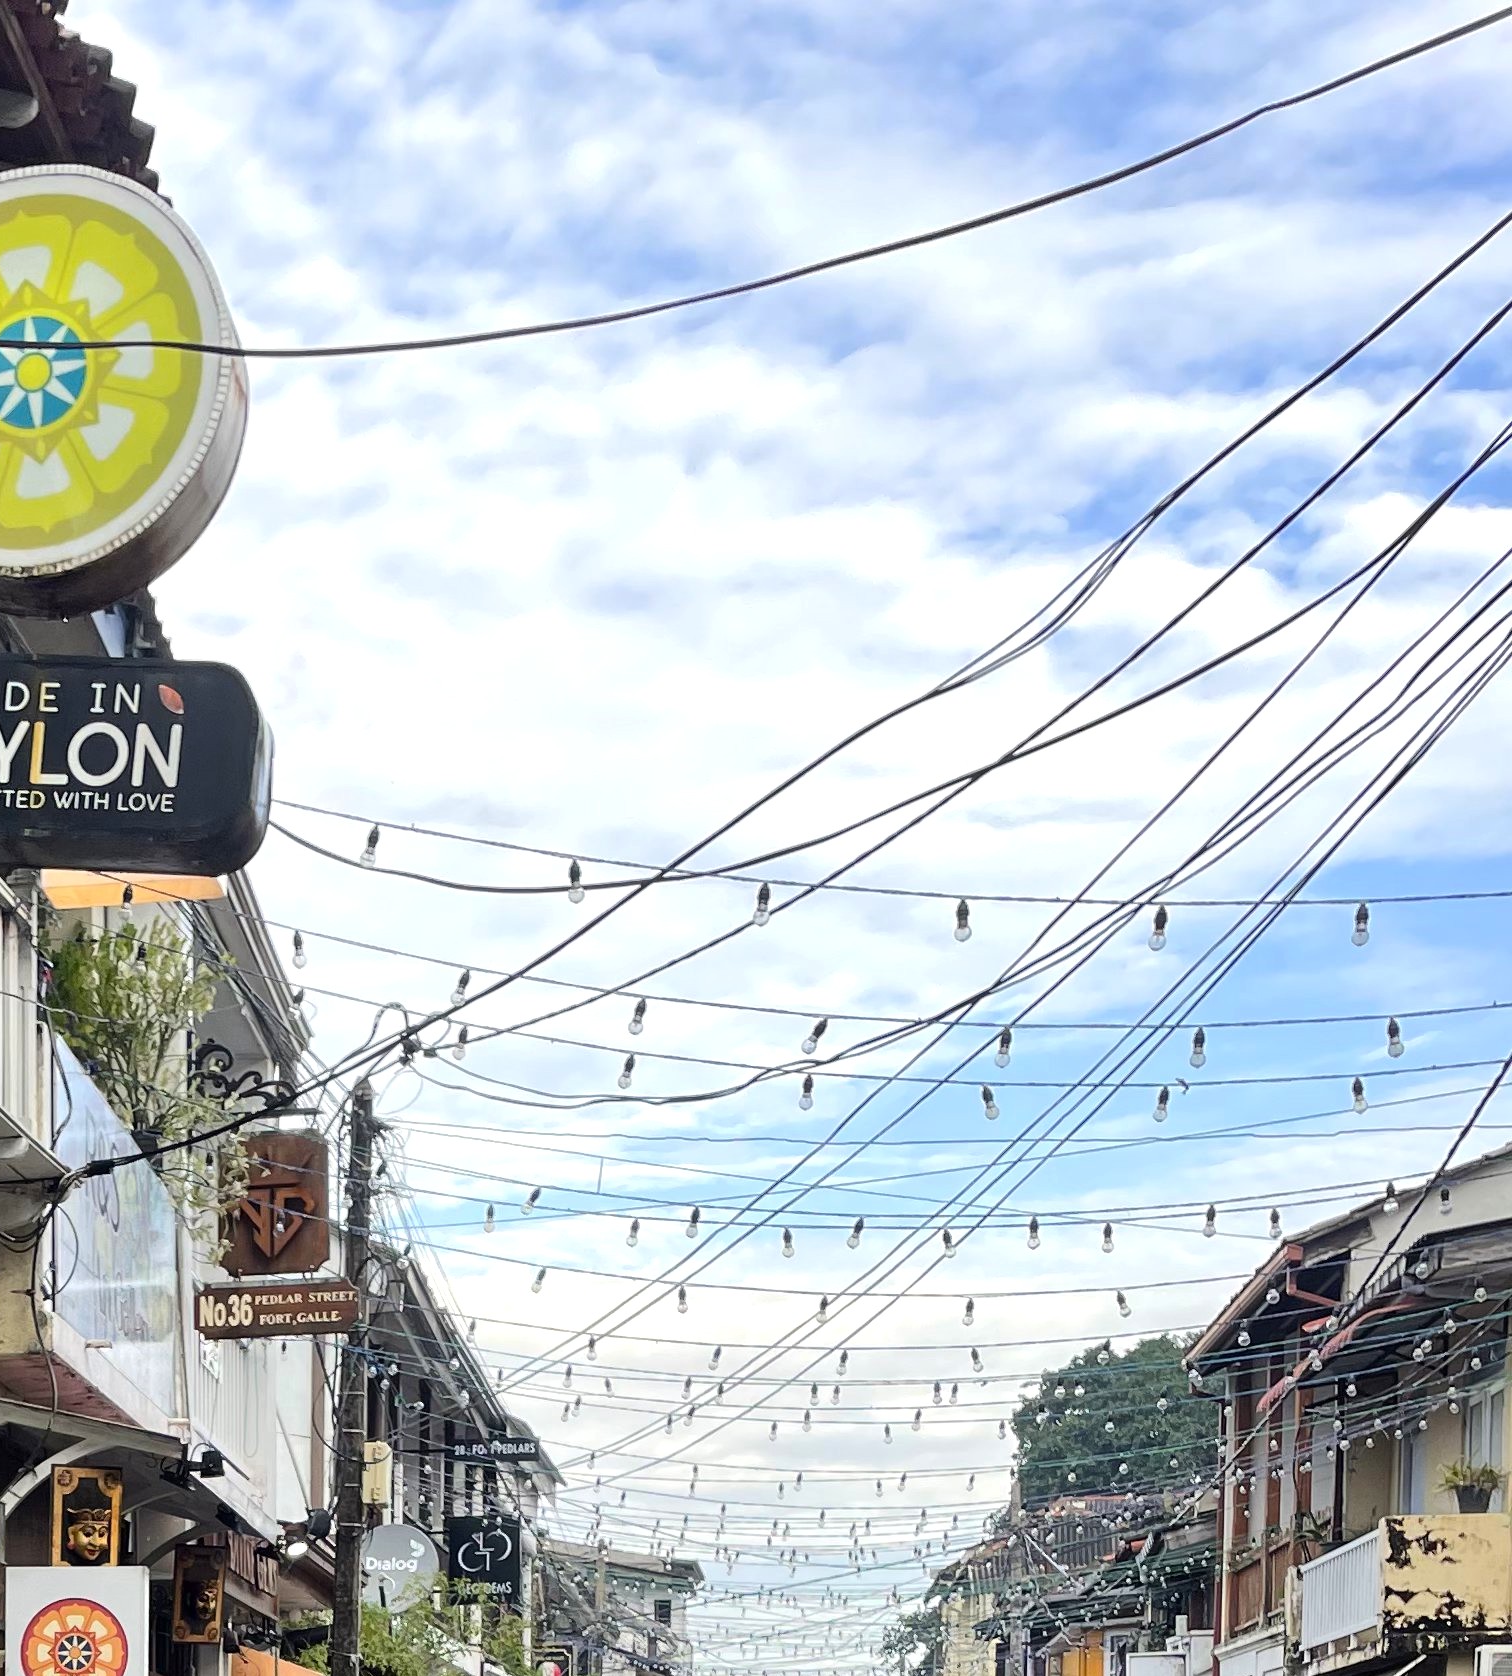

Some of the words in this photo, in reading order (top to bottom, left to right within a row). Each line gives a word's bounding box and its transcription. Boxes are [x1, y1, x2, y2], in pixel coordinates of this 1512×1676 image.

[91, 682, 141, 714] IN
[53, 790, 110, 811] WITH
[117, 792, 175, 813] LOVE
[255, 1293, 303, 1306] PEDLAR
[365, 1556, 418, 1573] Dialog
